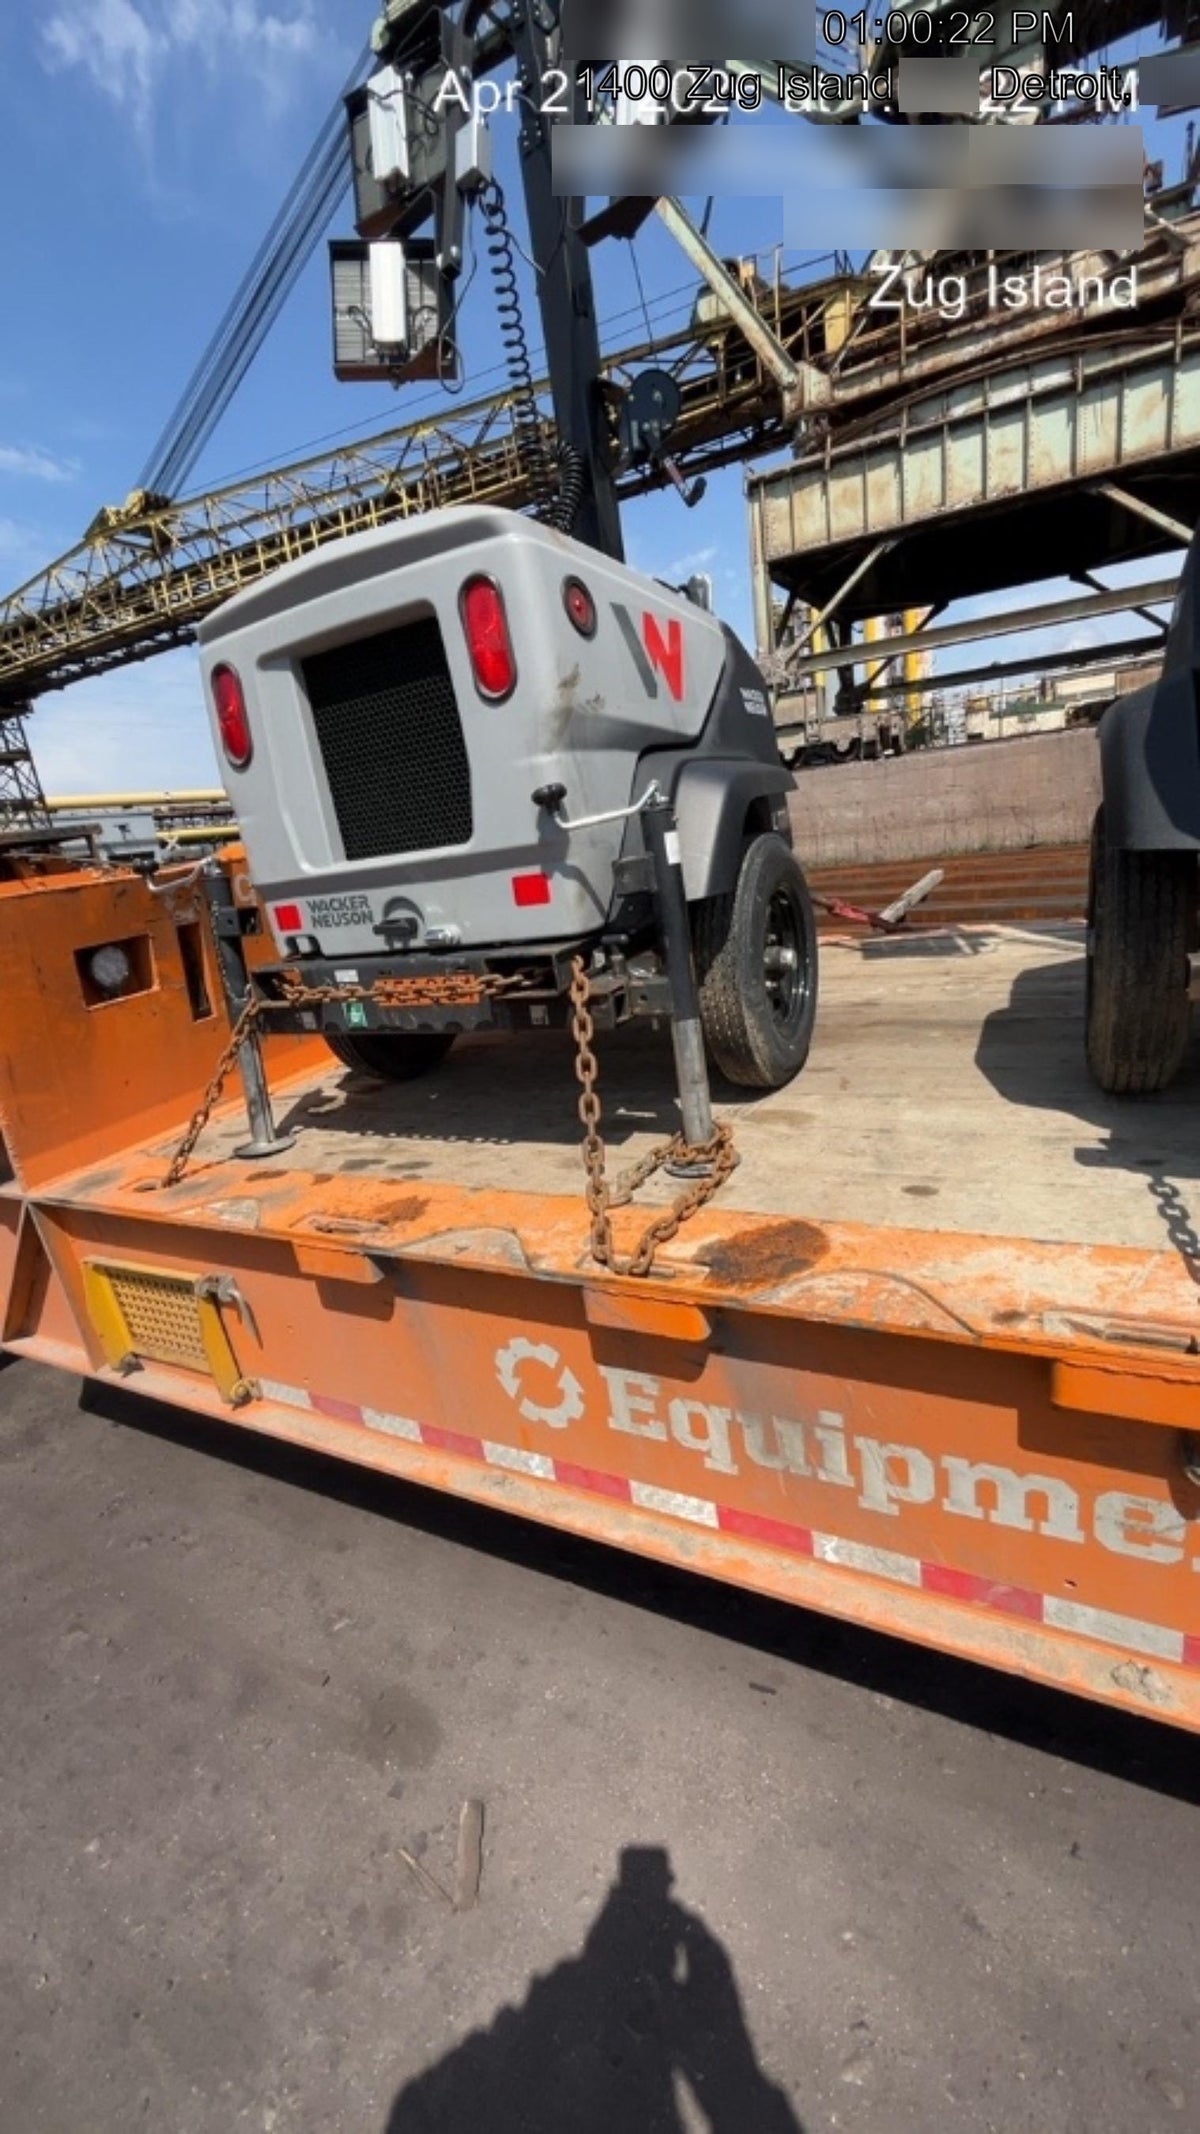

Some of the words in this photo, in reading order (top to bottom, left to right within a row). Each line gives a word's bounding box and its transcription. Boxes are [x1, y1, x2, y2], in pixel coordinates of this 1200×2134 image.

[306, 895, 370, 914] WACKER
[311, 910, 374, 929] NEUSON
[598, 1363, 1200, 1573] Equipme
